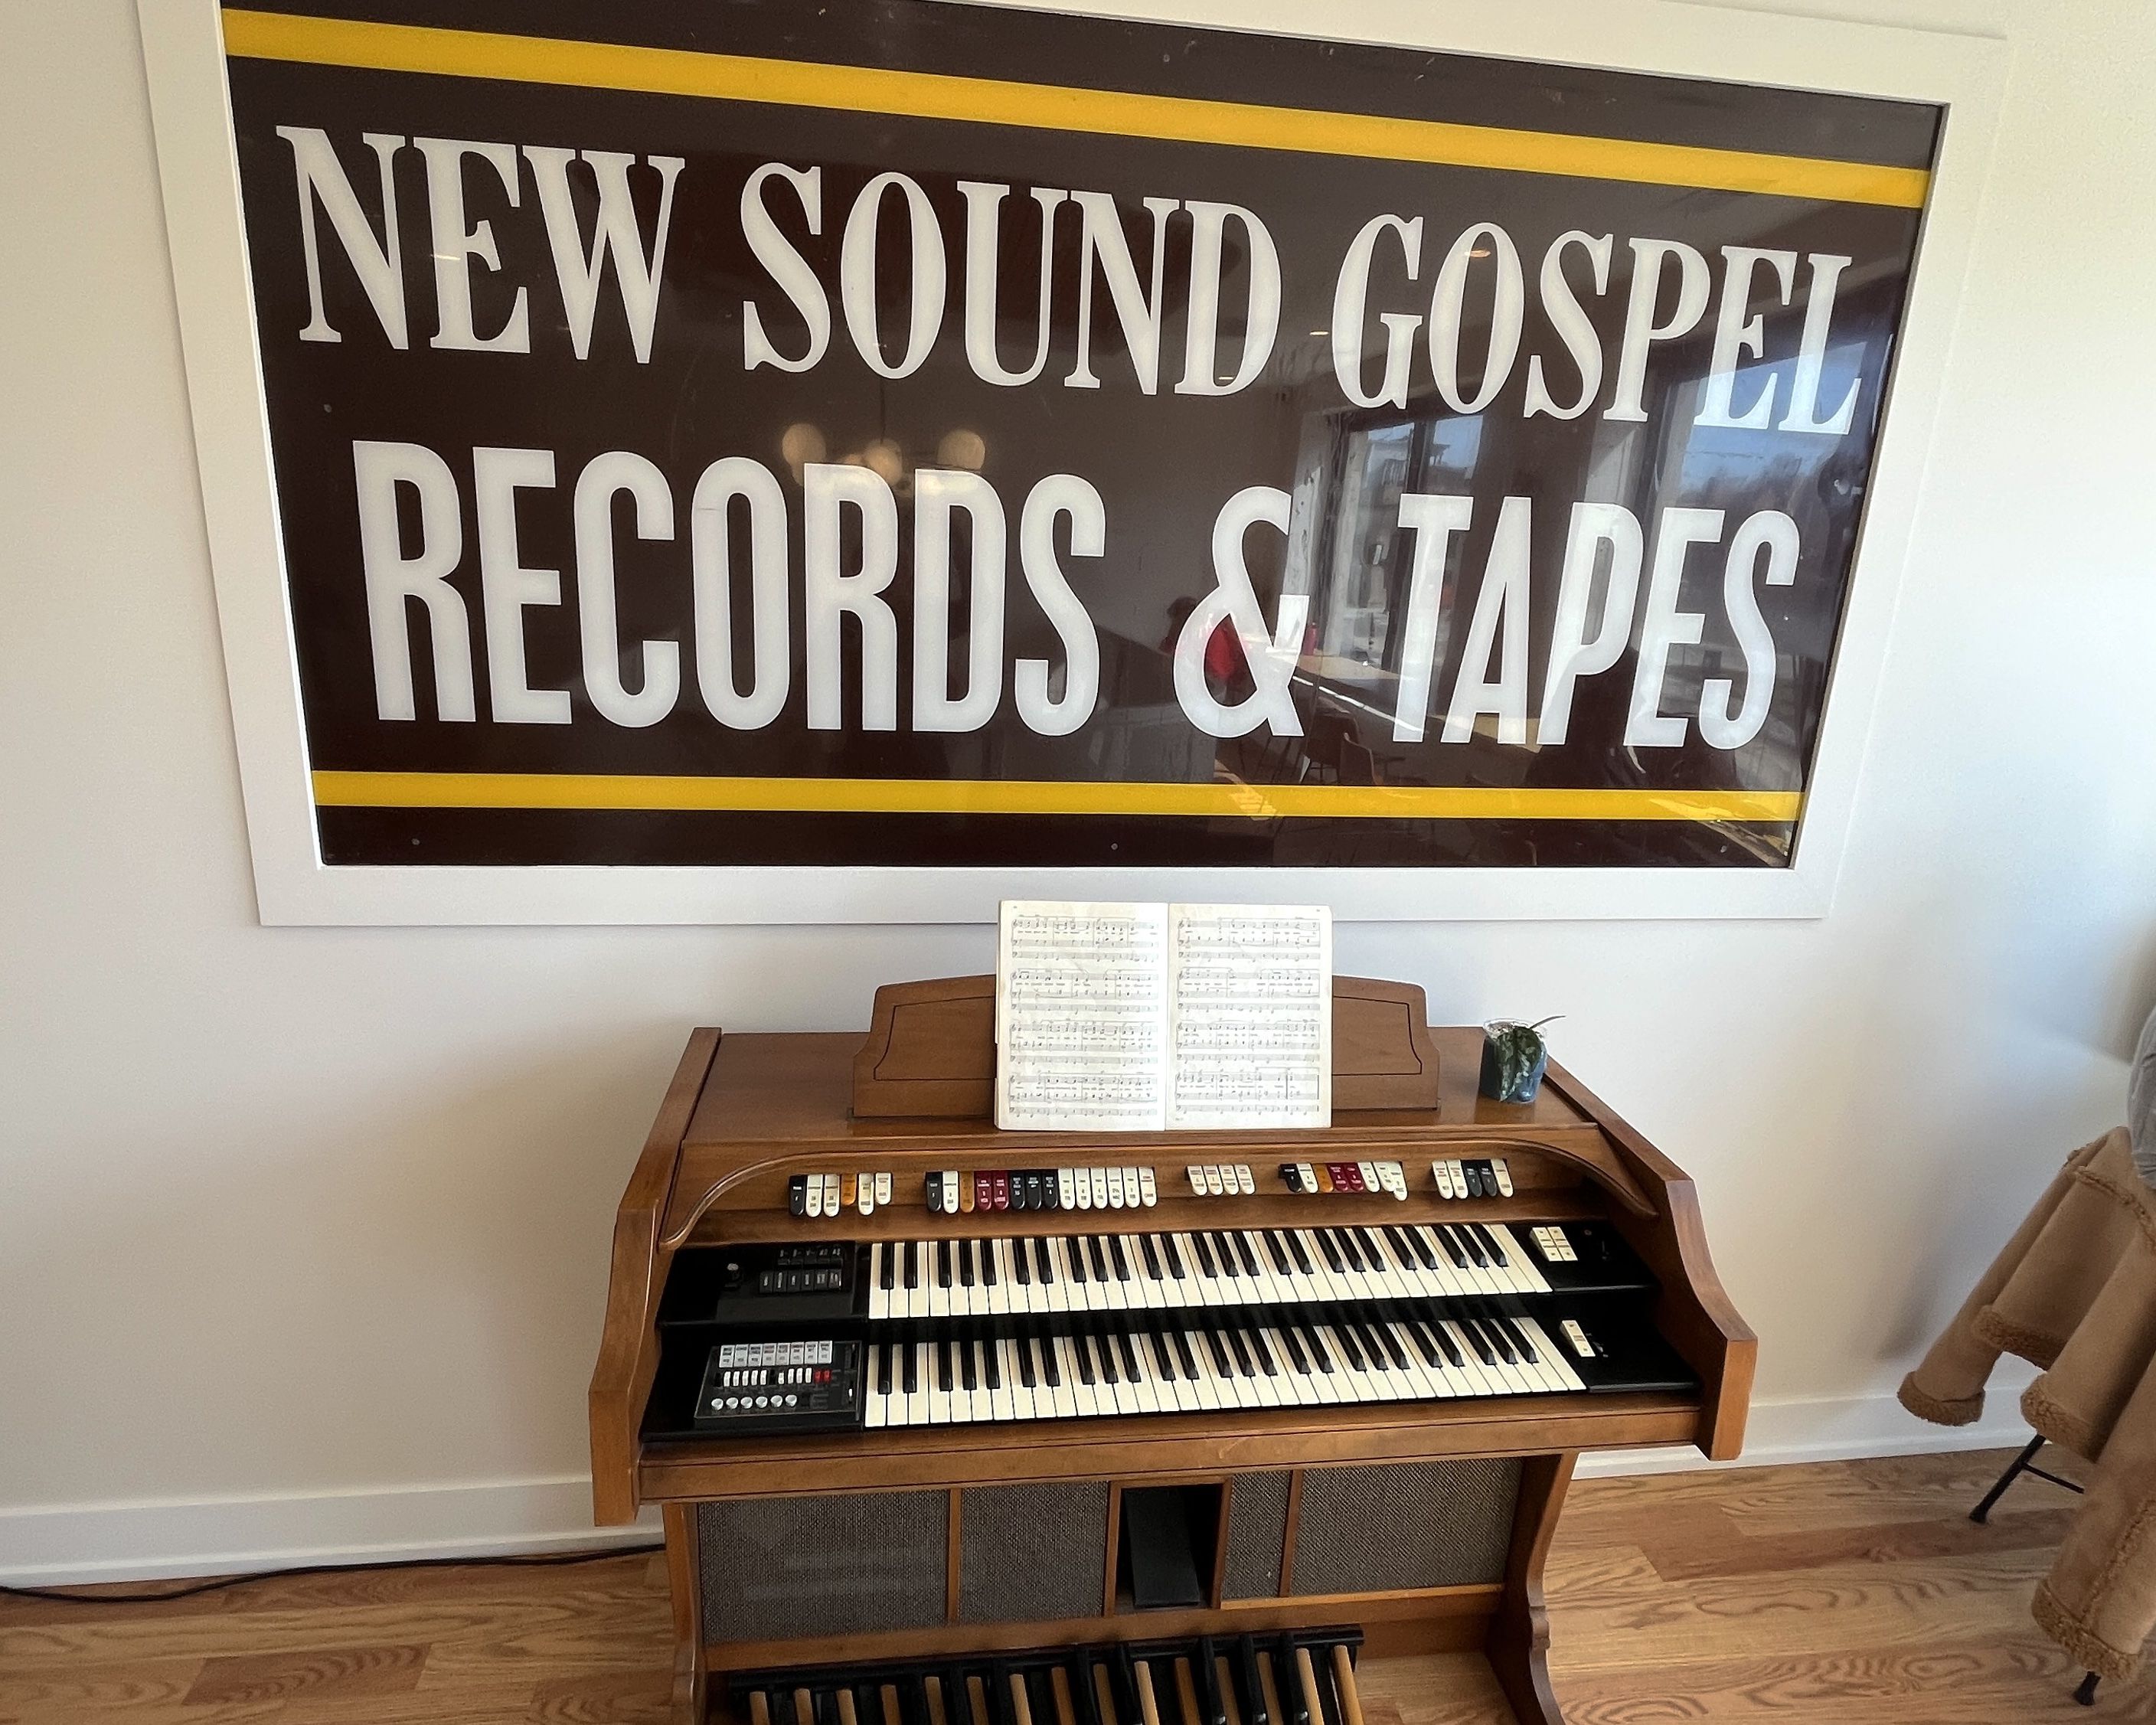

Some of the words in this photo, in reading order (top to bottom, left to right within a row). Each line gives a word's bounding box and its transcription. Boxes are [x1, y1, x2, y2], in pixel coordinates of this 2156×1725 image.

[276, 125, 685, 364] NEW
[740, 162, 1282, 396] SOUND
[1331, 214, 1863, 435] GOSPEL
[352, 439, 1106, 737] RECORDS
[1173, 485, 1311, 738] &
[1392, 494, 1801, 750] TAPES
